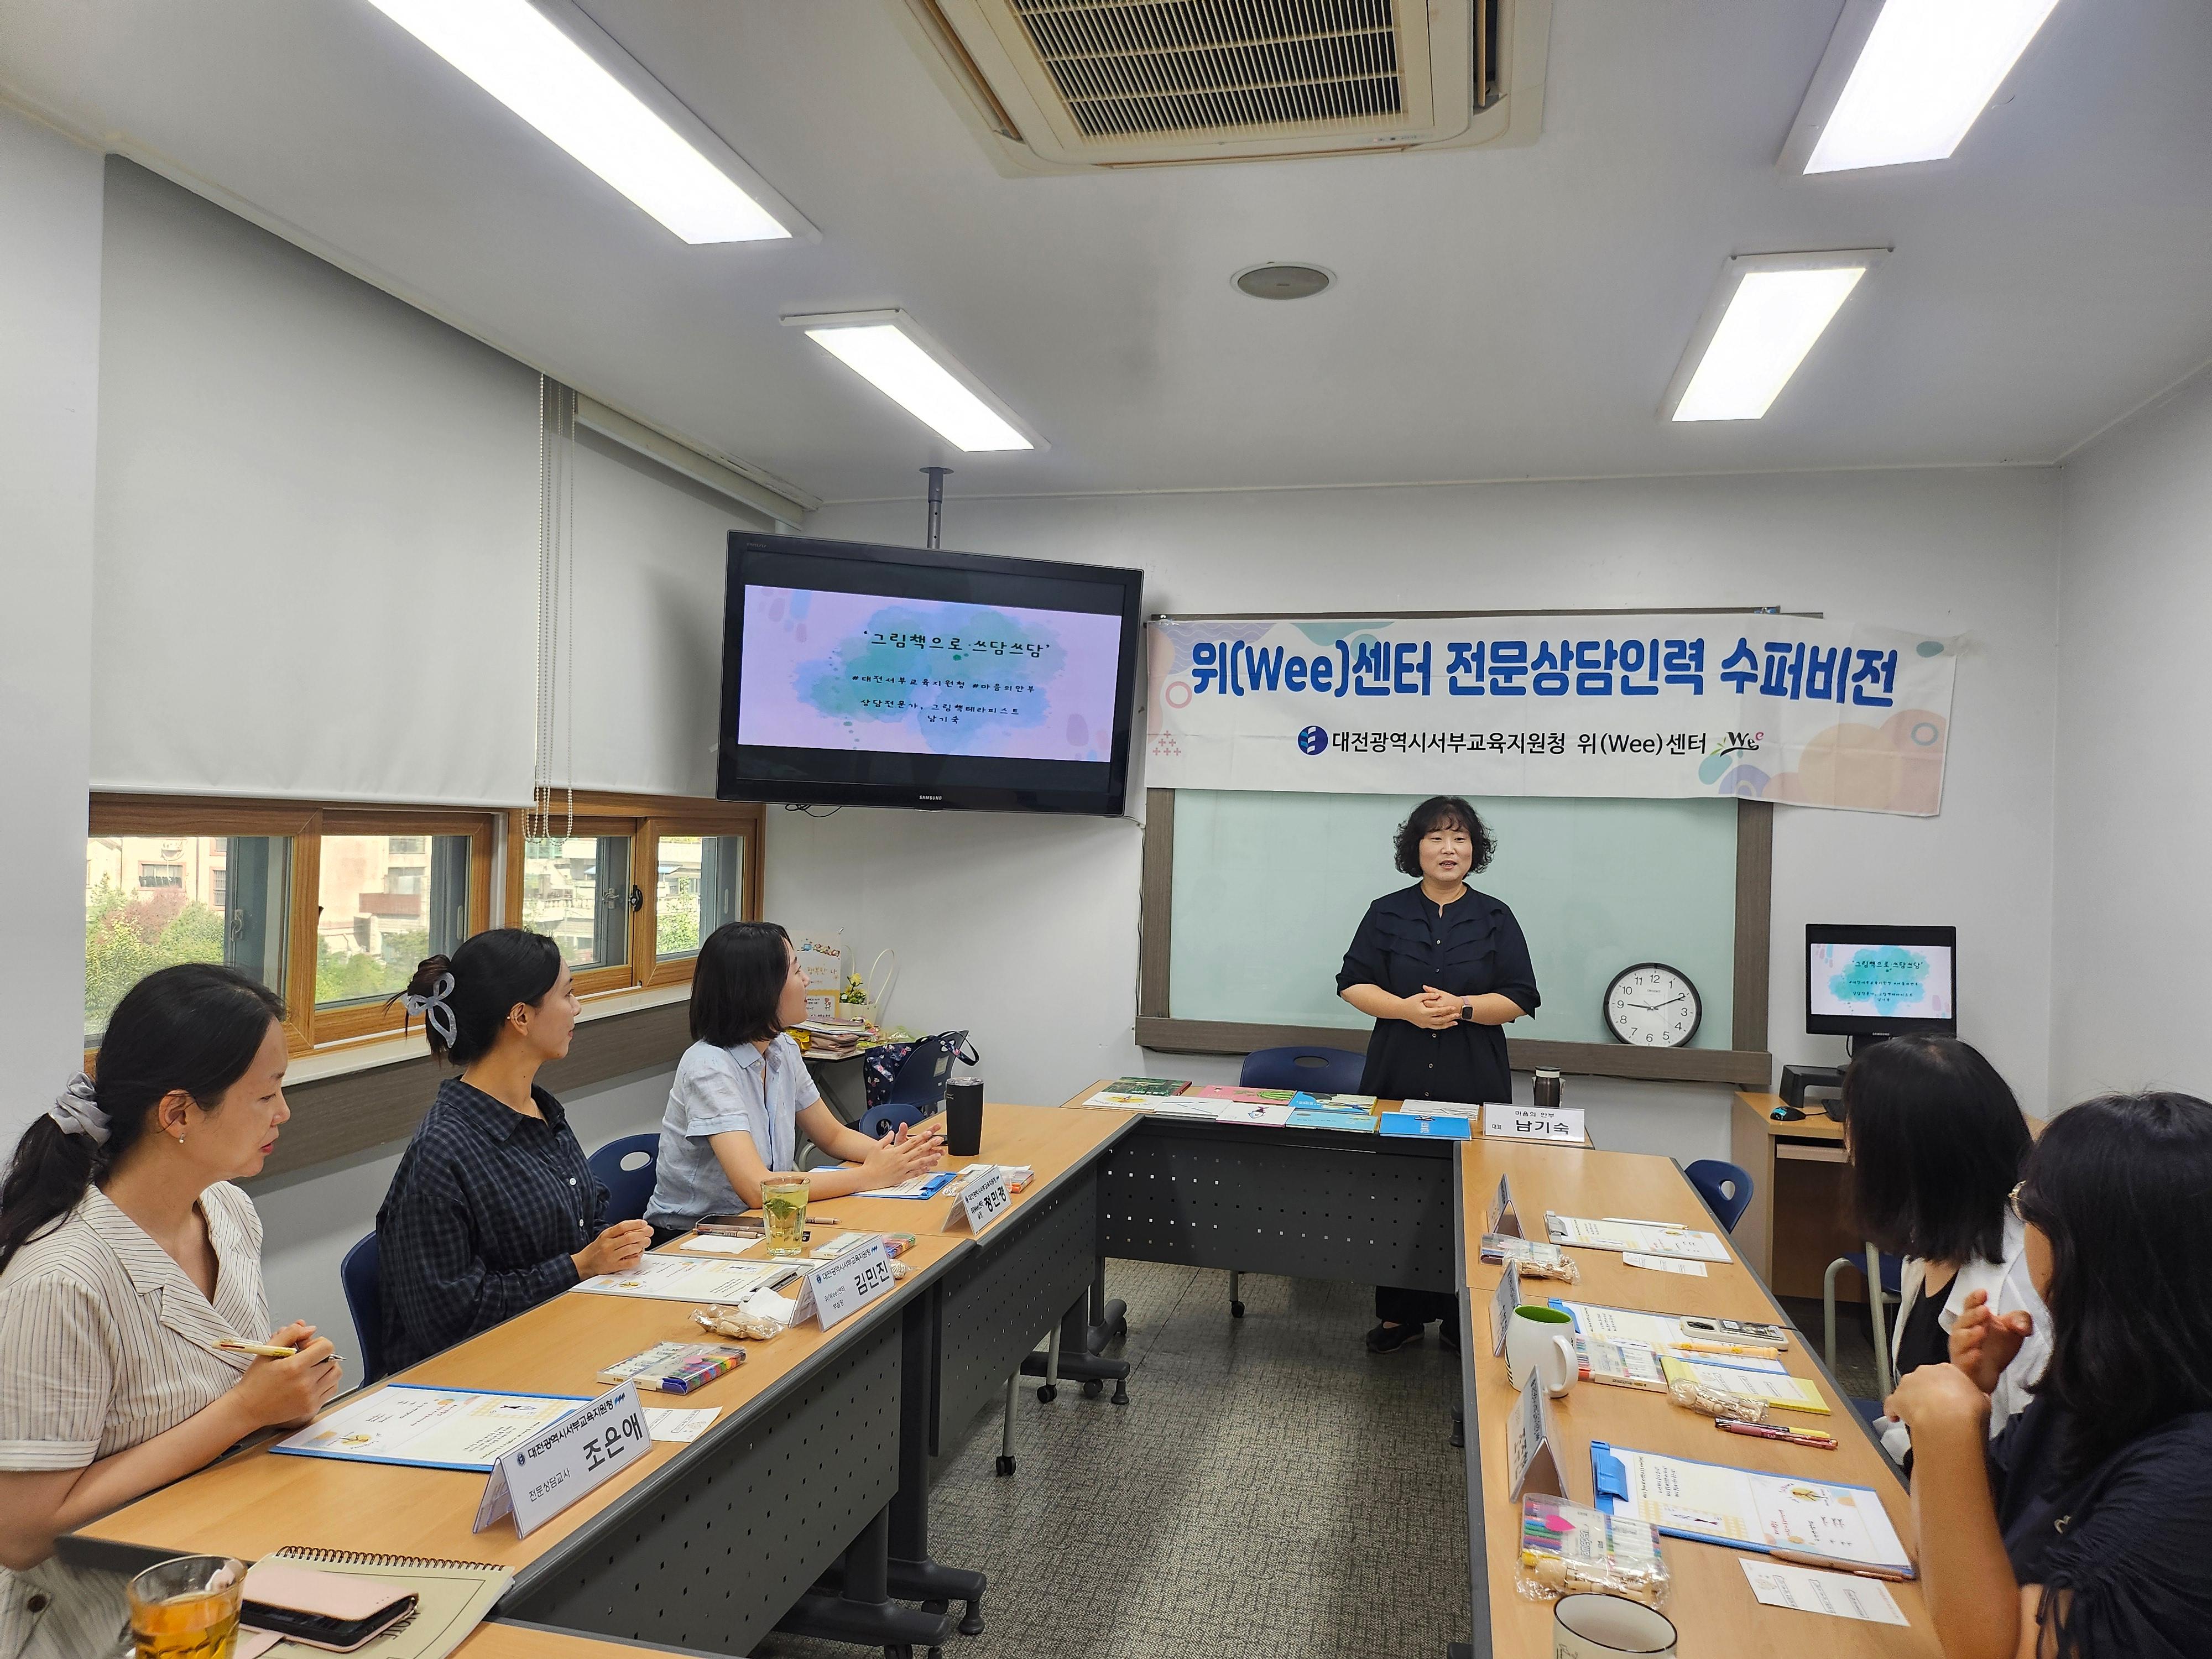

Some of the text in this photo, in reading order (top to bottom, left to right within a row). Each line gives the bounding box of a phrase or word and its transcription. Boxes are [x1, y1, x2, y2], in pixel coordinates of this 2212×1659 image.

[1192, 637, 1898, 707] 위(Wee)센터 전문상담인력 수퍼비전
[852, 675, 1035, 693] #대전서부교육지원청 #마음의안부
[860, 699, 1019, 716] 상담전문가, 그림책테라피스트
[927, 715, 959, 724] 남기숙
[1332, 731, 1707, 755] 대전광역시서부교육지원청 위(Wee)센터
[1720, 732, 1764, 757] Wee
[1635, 977, 1642, 985] 11
[1650, 974, 1660, 984] 12
[1668, 980, 1673, 989] 1
[1622, 986, 1632, 995] 10
[1678, 992, 1686, 1001] 2
[1617, 1000, 1624, 1009] 9
[1681, 1008, 1688, 1016] 3
[1620, 1015, 1627, 1024] 8
[1631, 1027, 1638, 1036] 7
[1674, 1022, 1682, 1031] 4
[1646, 1034, 1653, 1042] 6
[1662, 1031, 1670, 1040] 5
[1515, 1119, 1569, 1135] 남기숙
[983, 1185, 1006, 1213] 정민경
[822, 1248, 872, 1280] 대전광역시서부교육지원청
[854, 1260, 890, 1296] 김민진
[528, 1399, 614, 1459] 대전광역시서부교육지원청
[583, 1412, 643, 1472] 조은애
[529, 1467, 571, 1503] 전문상담교사
